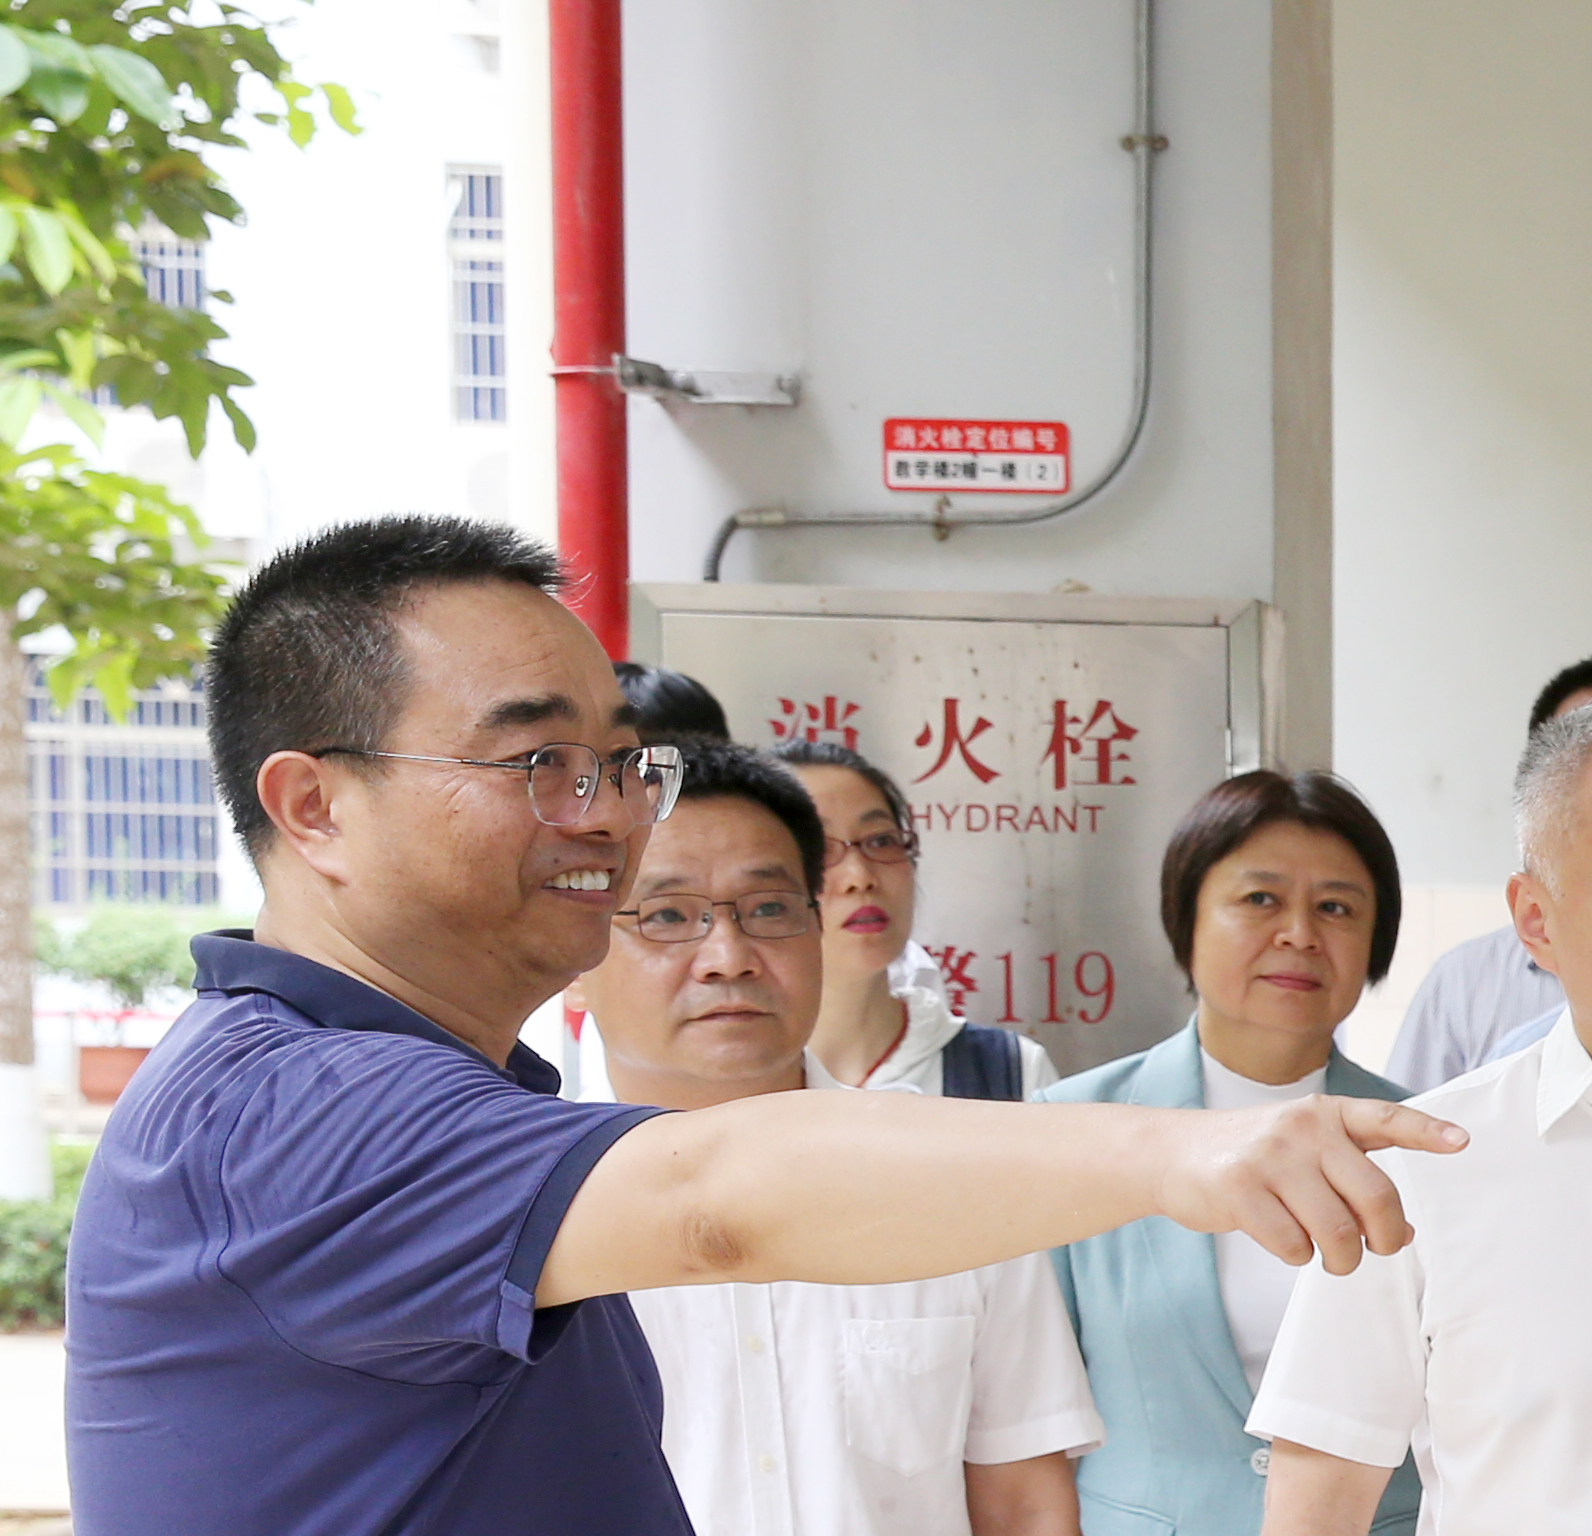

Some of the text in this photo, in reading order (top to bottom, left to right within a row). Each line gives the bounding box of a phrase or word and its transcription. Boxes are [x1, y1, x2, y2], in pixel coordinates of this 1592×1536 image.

[893, 425, 1058, 451] 消火栓定位编号
[906, 804, 1106, 833] HYDRANT
